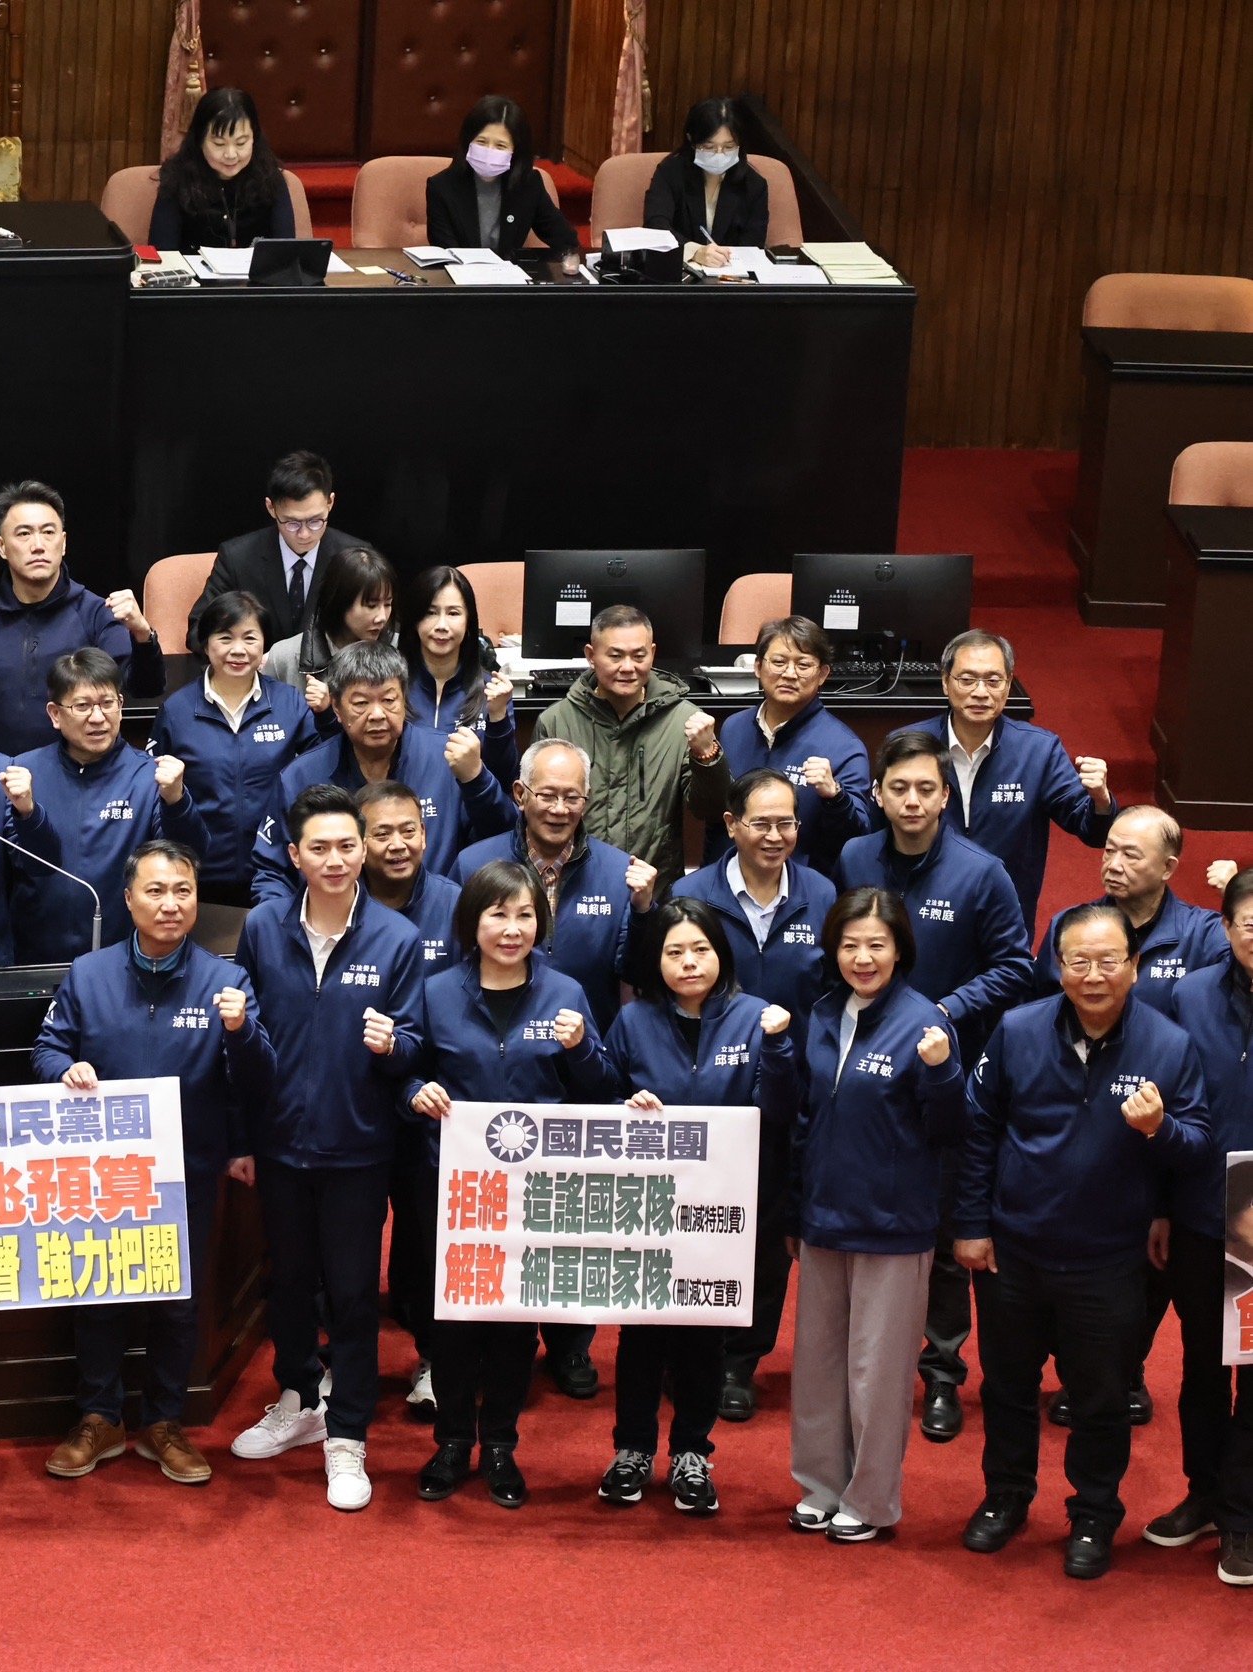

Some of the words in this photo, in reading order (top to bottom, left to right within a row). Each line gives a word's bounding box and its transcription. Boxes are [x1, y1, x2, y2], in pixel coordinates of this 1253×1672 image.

[991, 790, 1025, 802] 蘇清泉
[99, 808, 134, 820] 林思銘
[576, 903, 612, 916] 陳超明
[918, 906, 954, 922] 牛煦庭
[783, 932, 816, 945] 鄭天財
[424, 948, 448, 960] 縣一
[340, 972, 380, 987] 廖偉翔
[172, 1016, 210, 1029] 涂權吉
[856, 1059, 893, 1078] 王育敏
[1110, 1082, 1142, 1096] 林德
[541, 1118, 708, 1161] 國民黨團
[447, 1169, 508, 1232] 拒絕
[522, 1171, 676, 1236] 造謠國家隊
[675, 1204, 746, 1234] (刪減特別費)
[35, 1223, 182, 1300] 強力把關
[444, 1243, 506, 1306] 解散
[520, 1245, 673, 1310] 網軍國家隊
[672, 1278, 742, 1308] (刪減文宣費)
